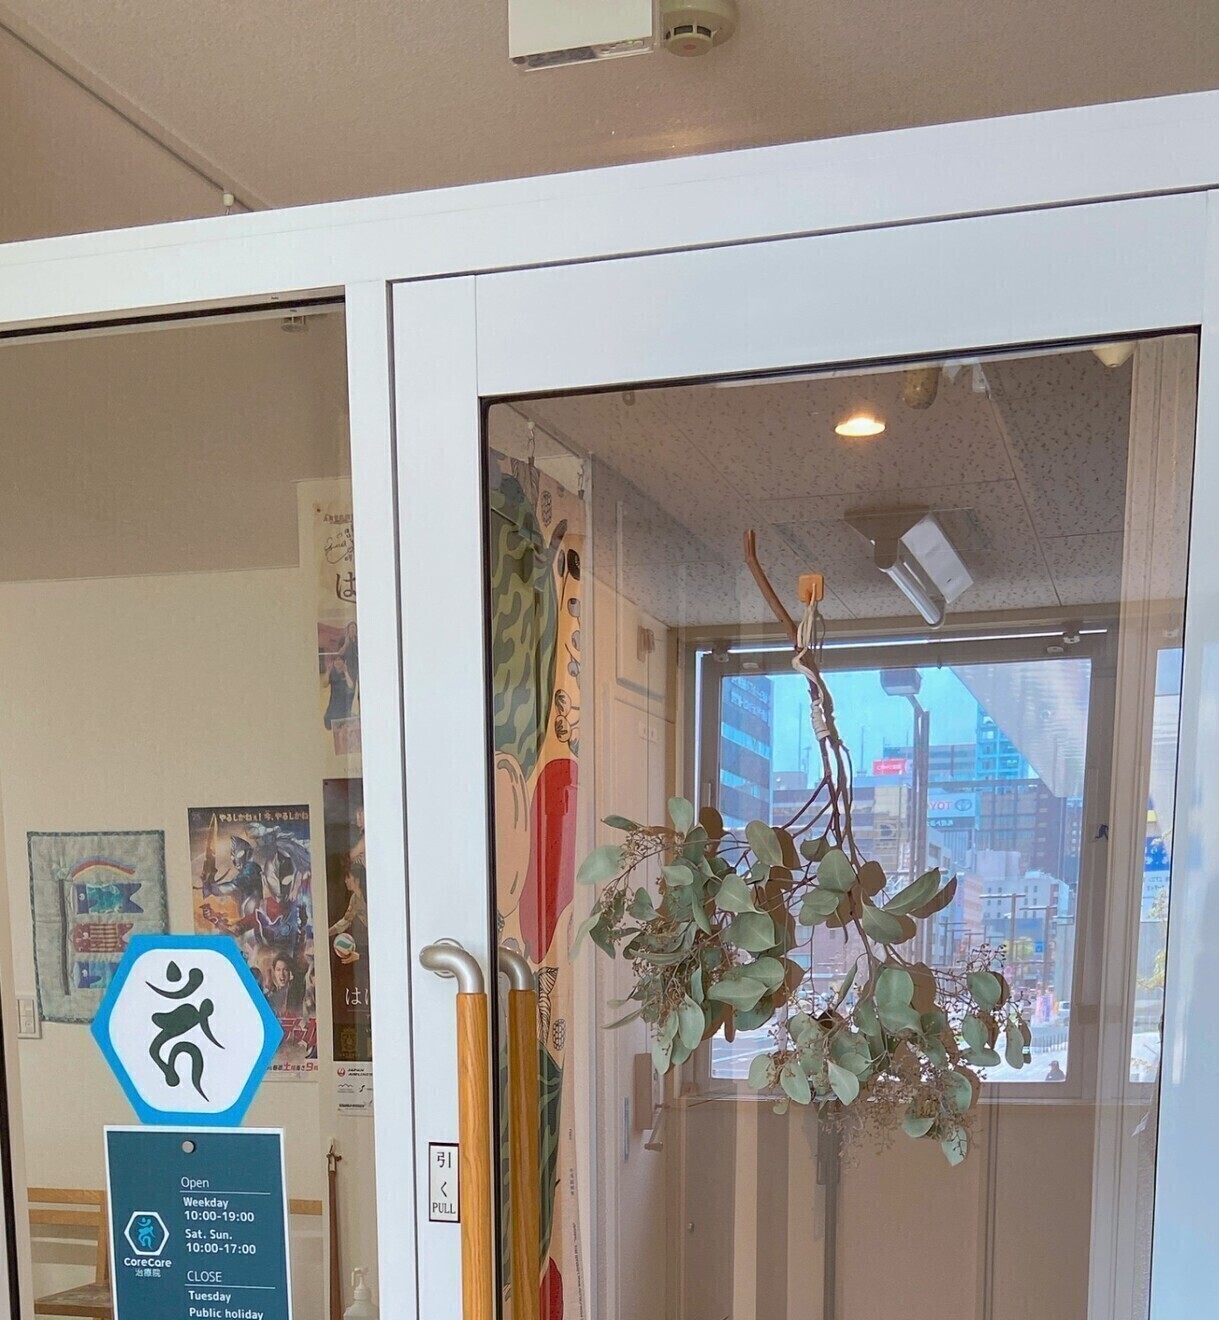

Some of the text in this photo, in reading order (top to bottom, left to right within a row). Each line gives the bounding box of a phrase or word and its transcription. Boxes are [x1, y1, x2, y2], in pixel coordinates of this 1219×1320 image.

[436, 1151, 452, 1198] 引く
[181, 1176, 210, 1190] Open
[183, 1197, 229, 1210] Weekday
[432, 1202, 456, 1215] PULL
[184, 1210, 255, 1222] 10:00-19:00
[185, 1228, 233, 1240] Sat. Sun.
[186, 1242, 257, 1255] 10:00-17:00
[124, 1257, 172, 1267] CoreCare
[135, 1268, 162, 1278] 治療院
[187, 1270, 223, 1283] CLOSE
[188, 1290, 232, 1304] Tuesday
[189, 1307, 222, 1318] Public
